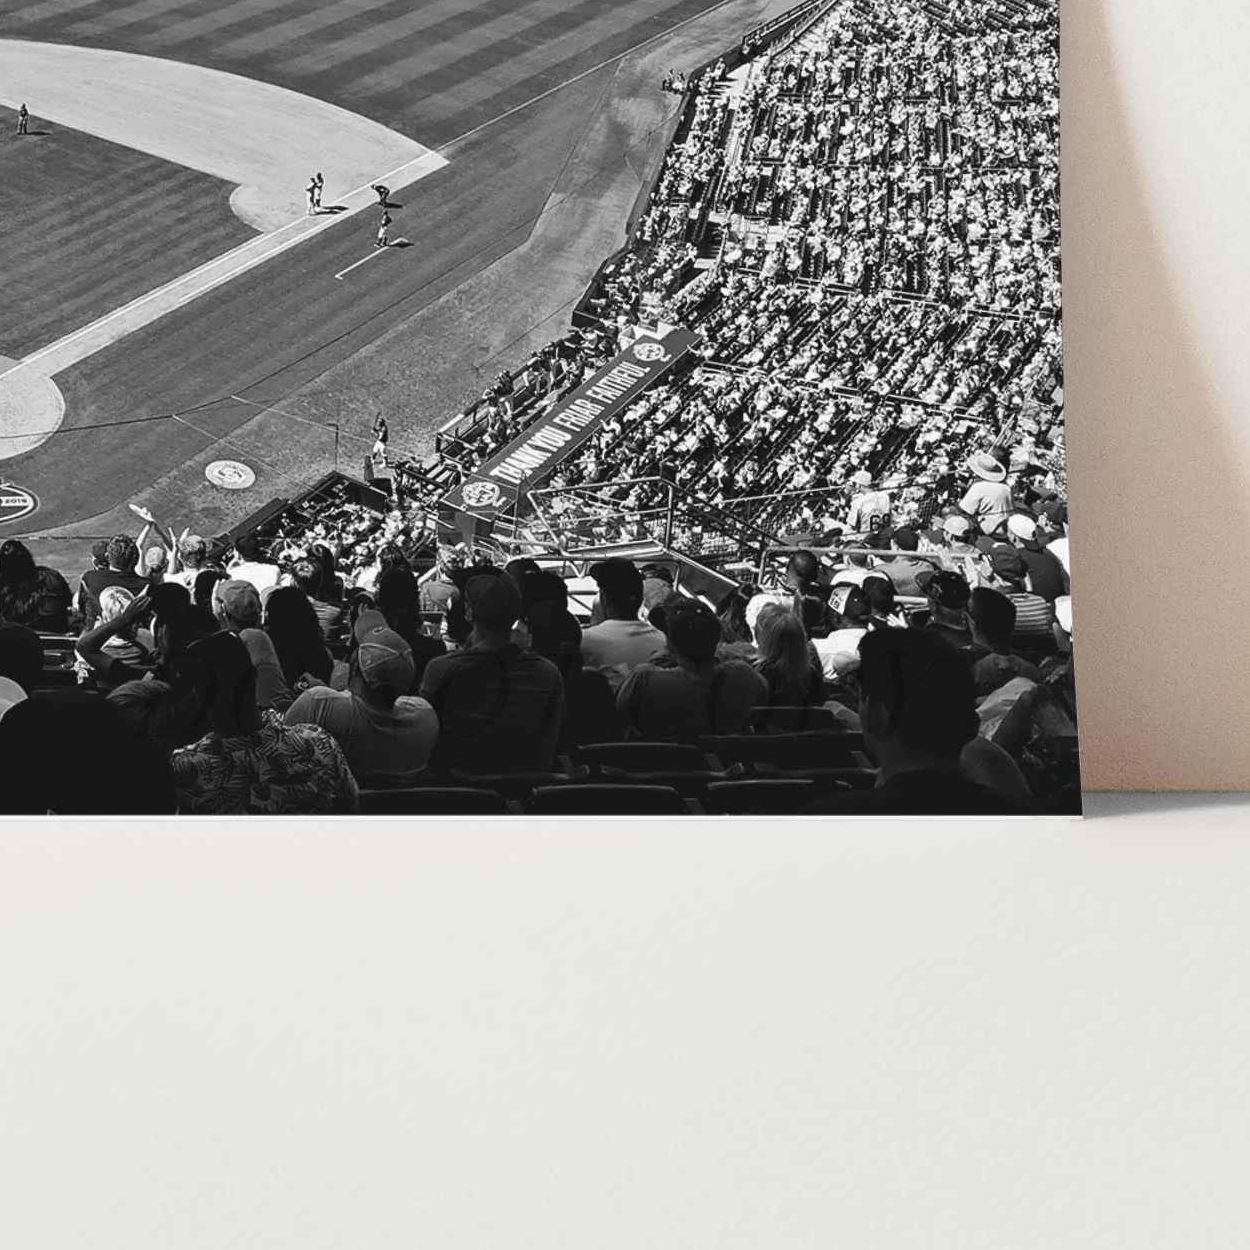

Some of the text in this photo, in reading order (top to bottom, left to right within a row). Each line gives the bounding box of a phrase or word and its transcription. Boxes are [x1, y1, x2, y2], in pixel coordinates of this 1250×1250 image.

[489, 360, 651, 485] THANK YOU FRIAR FAITHFUL
